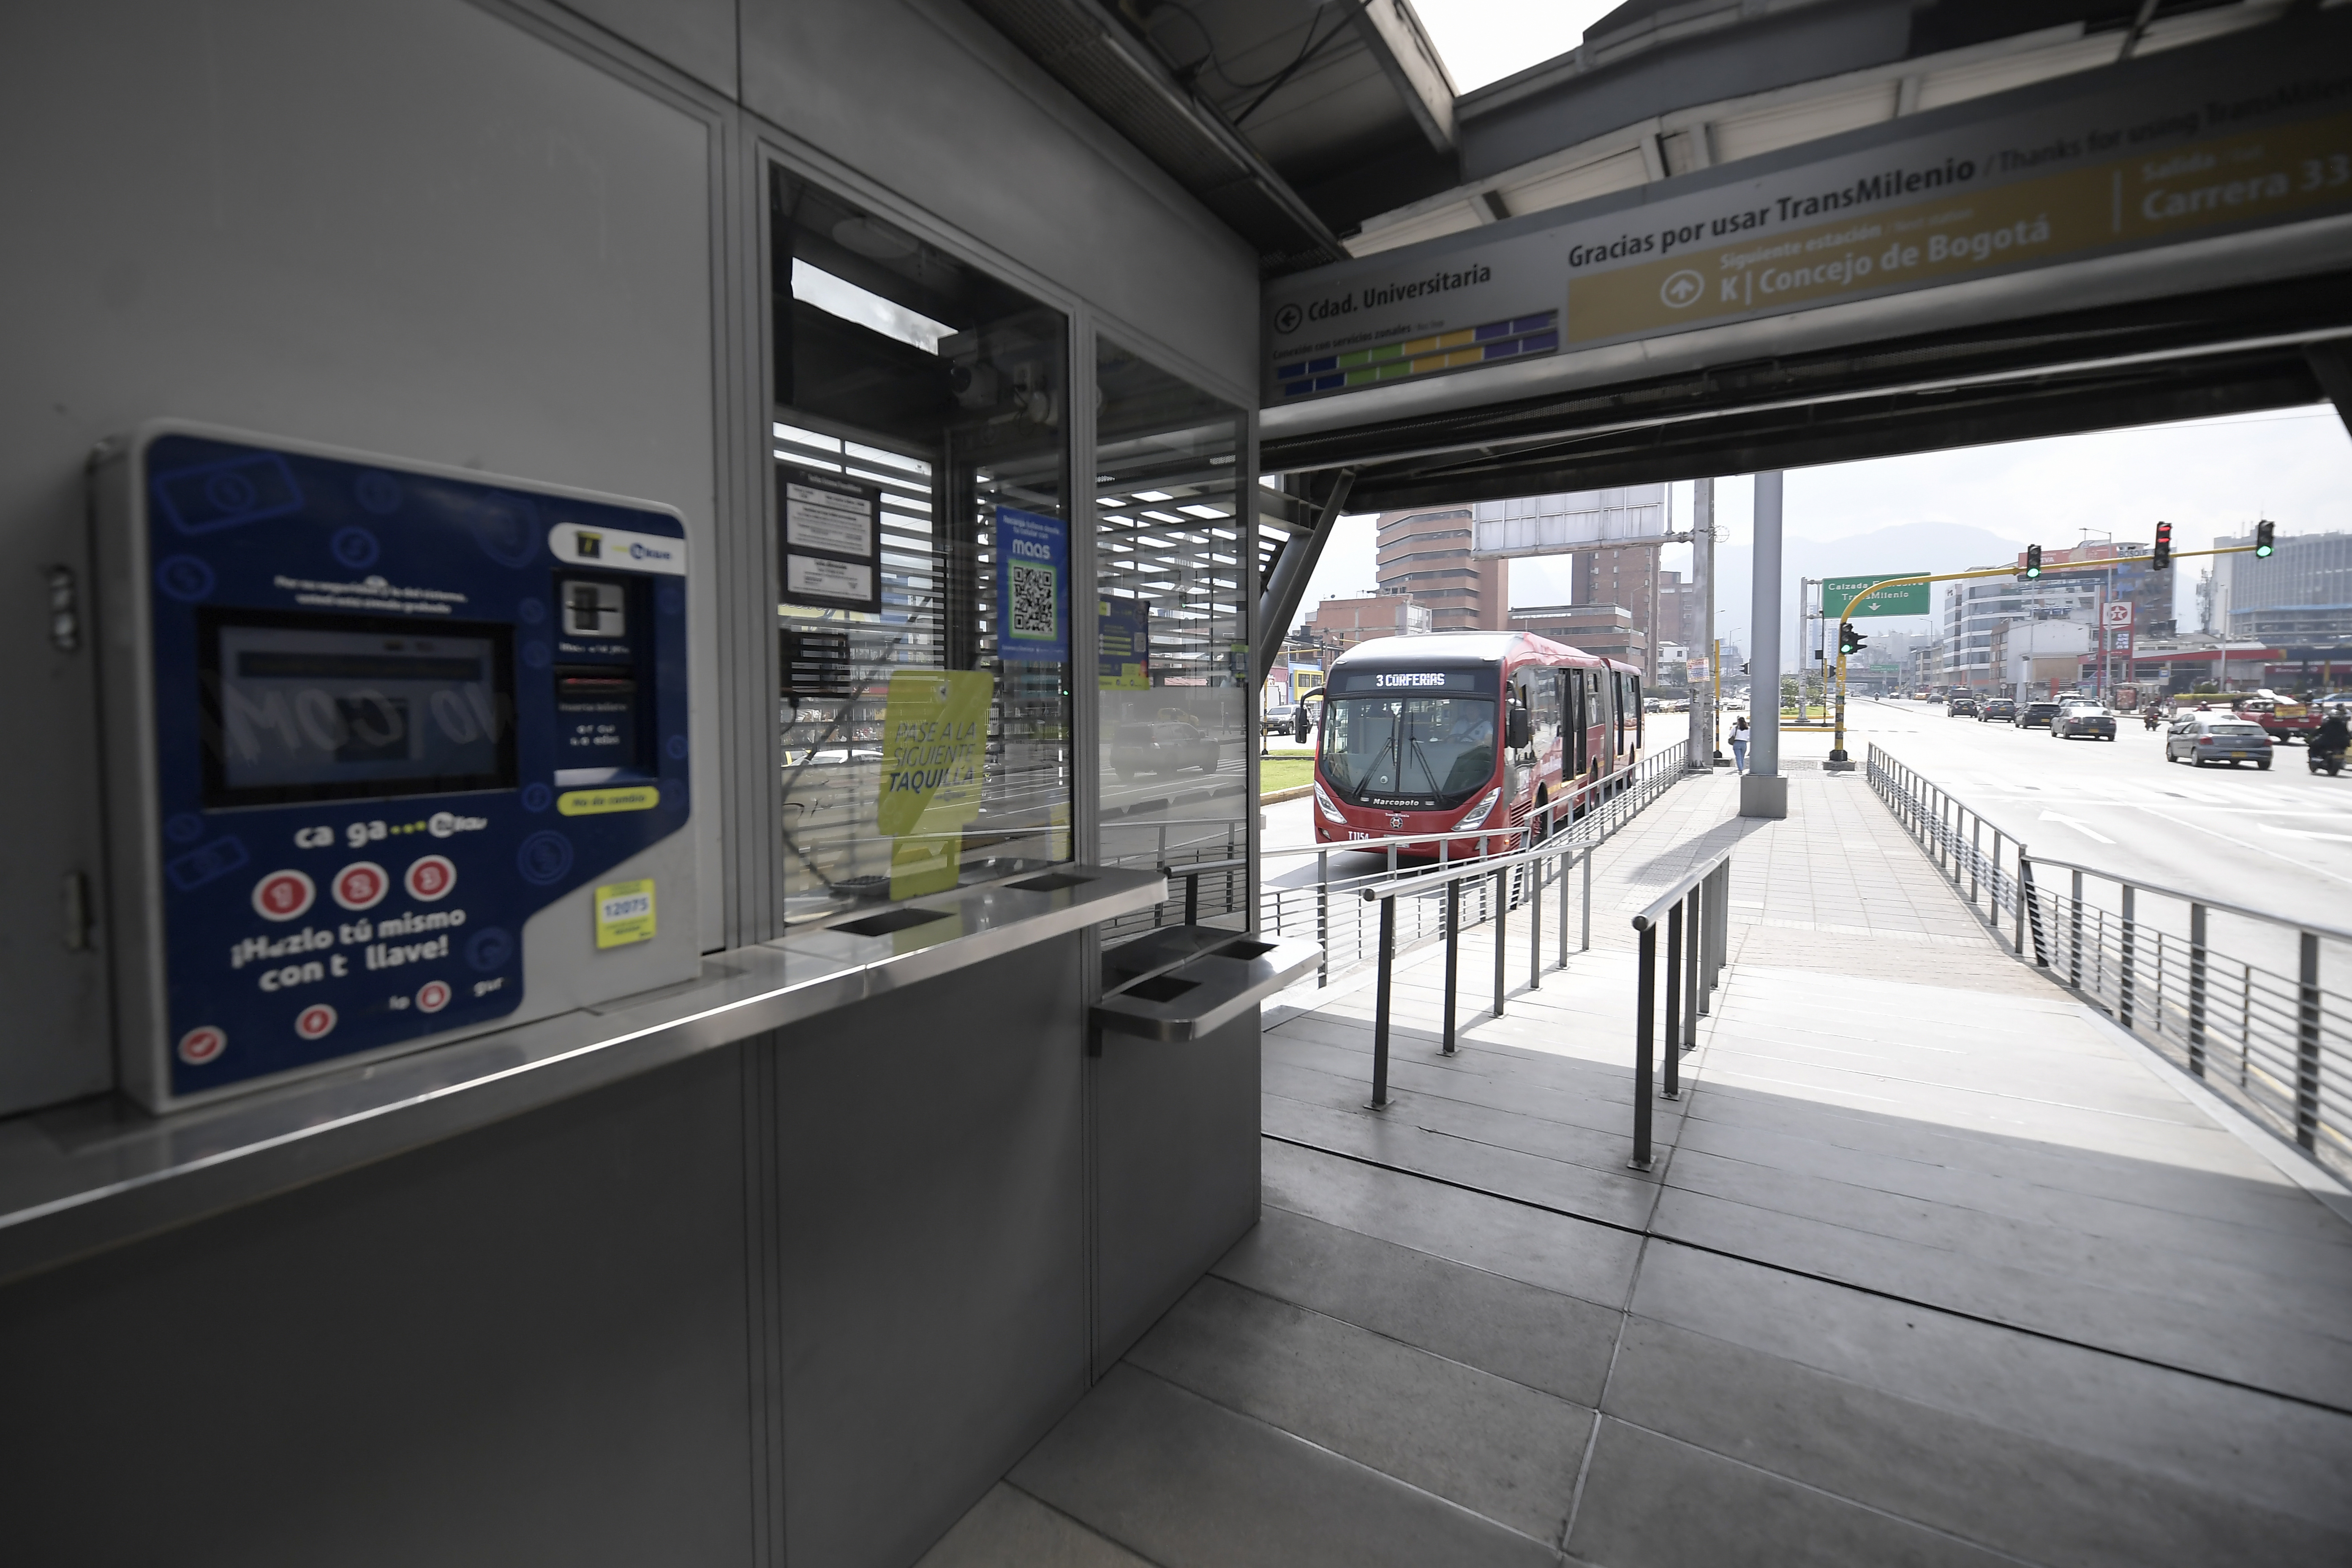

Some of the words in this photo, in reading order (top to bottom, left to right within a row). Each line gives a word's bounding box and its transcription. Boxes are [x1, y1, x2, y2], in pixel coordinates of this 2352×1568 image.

[1569, 234, 1653, 267] Gracias
[1661, 222, 1705, 253] por
[1711, 207, 1771, 237] usar
[1777, 158, 1976, 221] TransMilenio
[1999, 138, 2081, 172] Thanks
[2088, 129, 2121, 154] for
[2127, 112, 2198, 144] using
[2142, 171, 2290, 221] Carrera
[2300, 153, 2351, 191] 33
[1720, 240, 1801, 269] Siguiente
[1805, 223, 1882, 252] estación
[1720, 277, 1738, 302] K
[1759, 253, 1873, 294] Concejo
[1881, 242, 1919, 272] de
[1928, 213, 2050, 263] Bogotá
[1309, 293, 1357, 321] Cdad.
[1364, 264, 1491, 308] Universitaria
[1012, 539, 1050, 560] maas
[1829, 582, 1868, 590] Calzada
[1842, 591, 1909, 601] TrsMilenio
[1376, 674, 1383, 687] 3
[896, 722, 938, 742] PASE
[940, 722, 952, 740] A
[956, 722, 976, 740] LA
[894, 744, 976, 767] SIGUIENTE
[890, 766, 975, 794] TAQUILLA
[1373, 798, 1419, 806] Marcopolo
[1348, 831, 1369, 840] T1154
[604, 897, 648, 917] 12075
[378, 909, 466, 938] mismo
[258, 961, 324, 992] con
[365, 934, 449, 970] llave!
